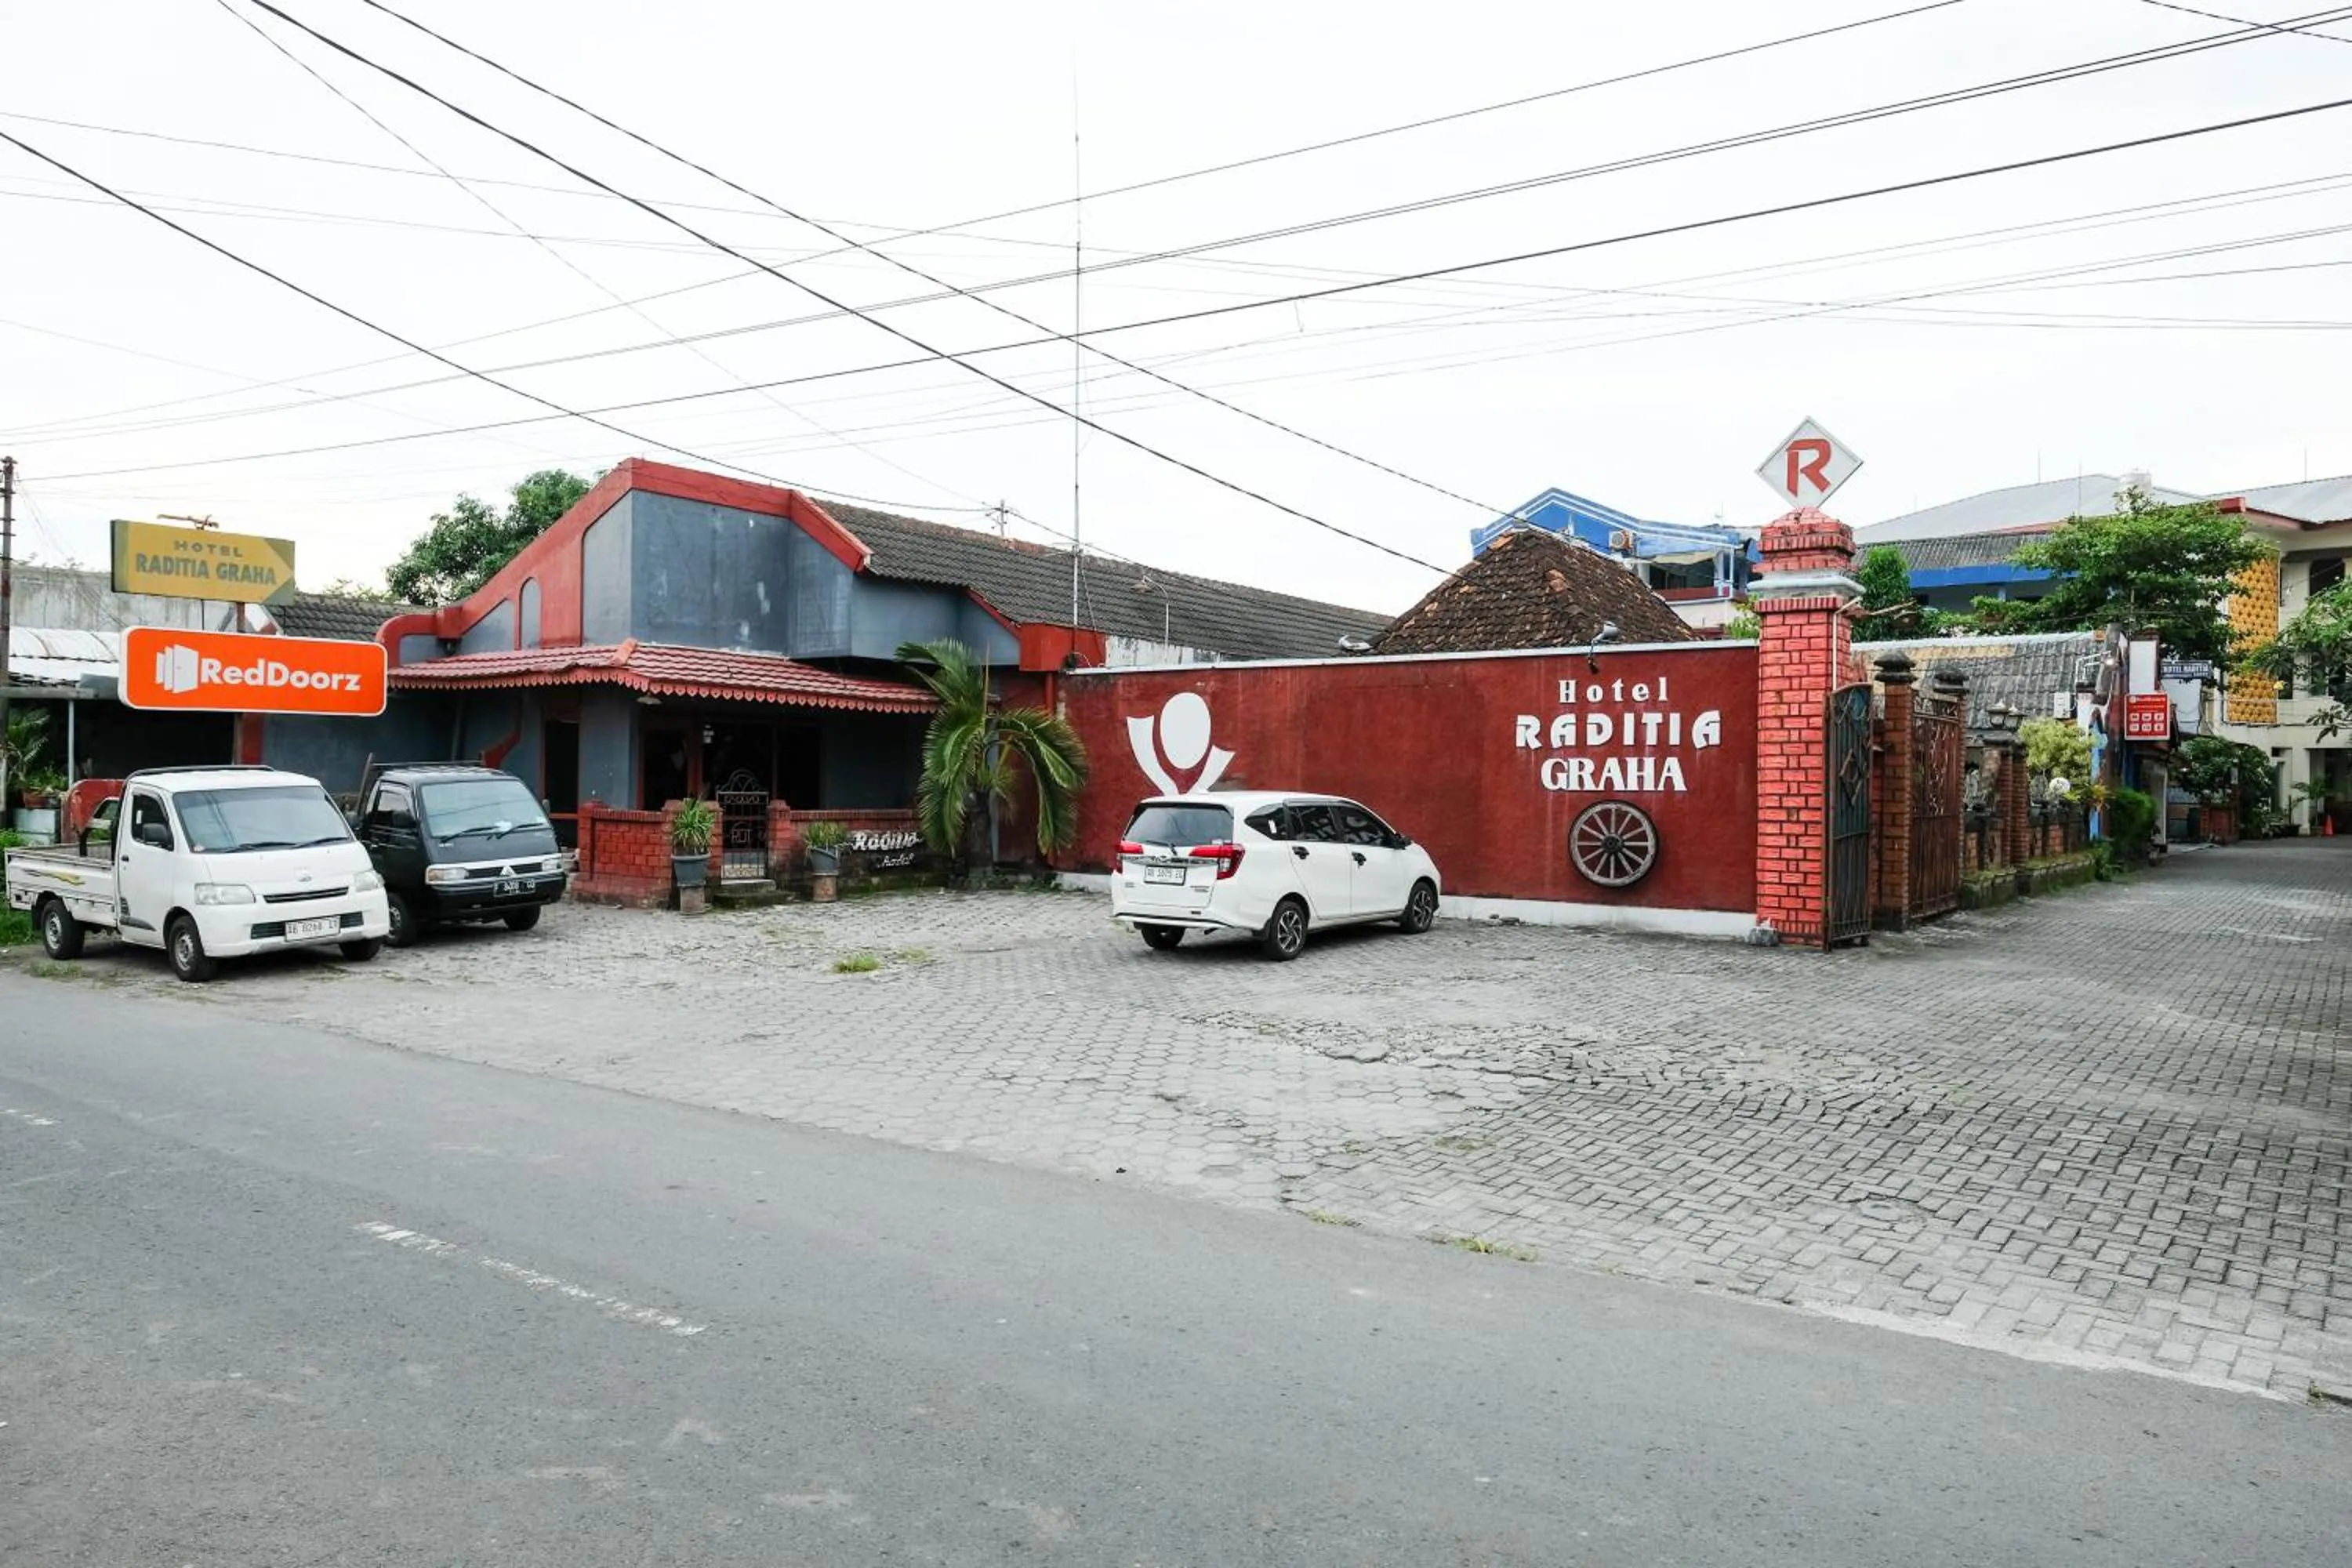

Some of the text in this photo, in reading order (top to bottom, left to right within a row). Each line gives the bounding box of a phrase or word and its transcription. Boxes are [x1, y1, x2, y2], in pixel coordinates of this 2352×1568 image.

[1785, 438, 1831, 498] R
[174, 540, 243, 557] HOTEL
[136, 553, 277, 585] RADITIA GRAHA
[201, 658, 361, 691] RedDoorz
[1559, 677, 1668, 703] Hotel
[1515, 710, 1721, 750] RADITIA
[1541, 757, 1687, 791] GRAHA
